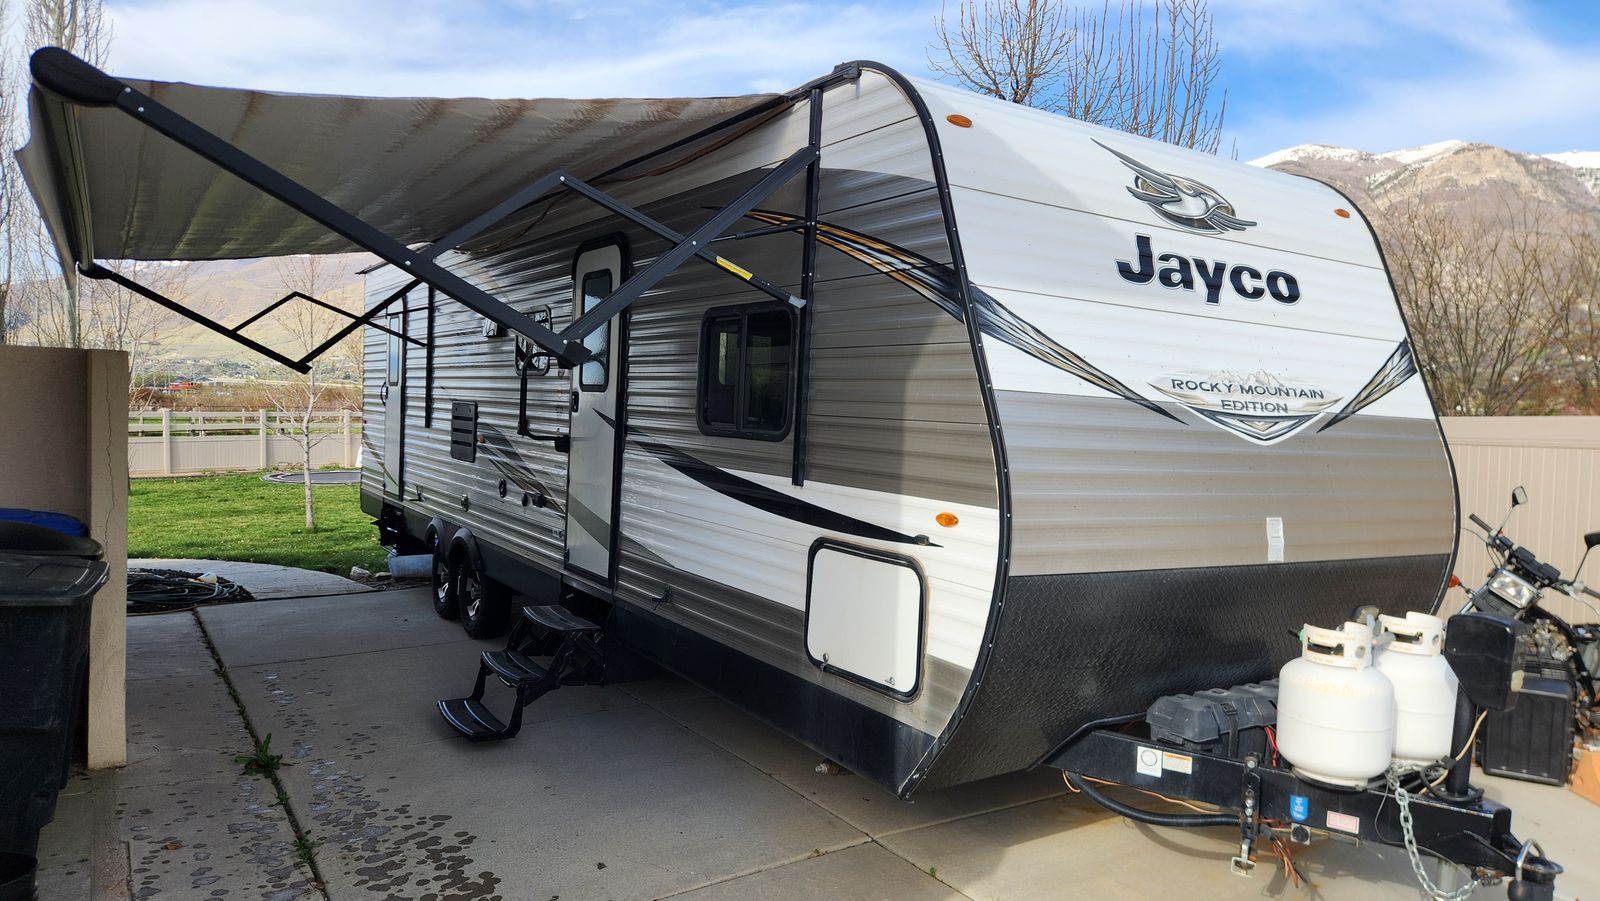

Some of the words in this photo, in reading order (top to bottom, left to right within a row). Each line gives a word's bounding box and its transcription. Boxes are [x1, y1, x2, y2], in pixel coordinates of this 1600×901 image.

[1115, 233, 1302, 306] Jayco
[1171, 378, 1233, 394] ROCKY
[1239, 384, 1325, 399] MOUNTAIN
[1221, 399, 1289, 414] EDITION
